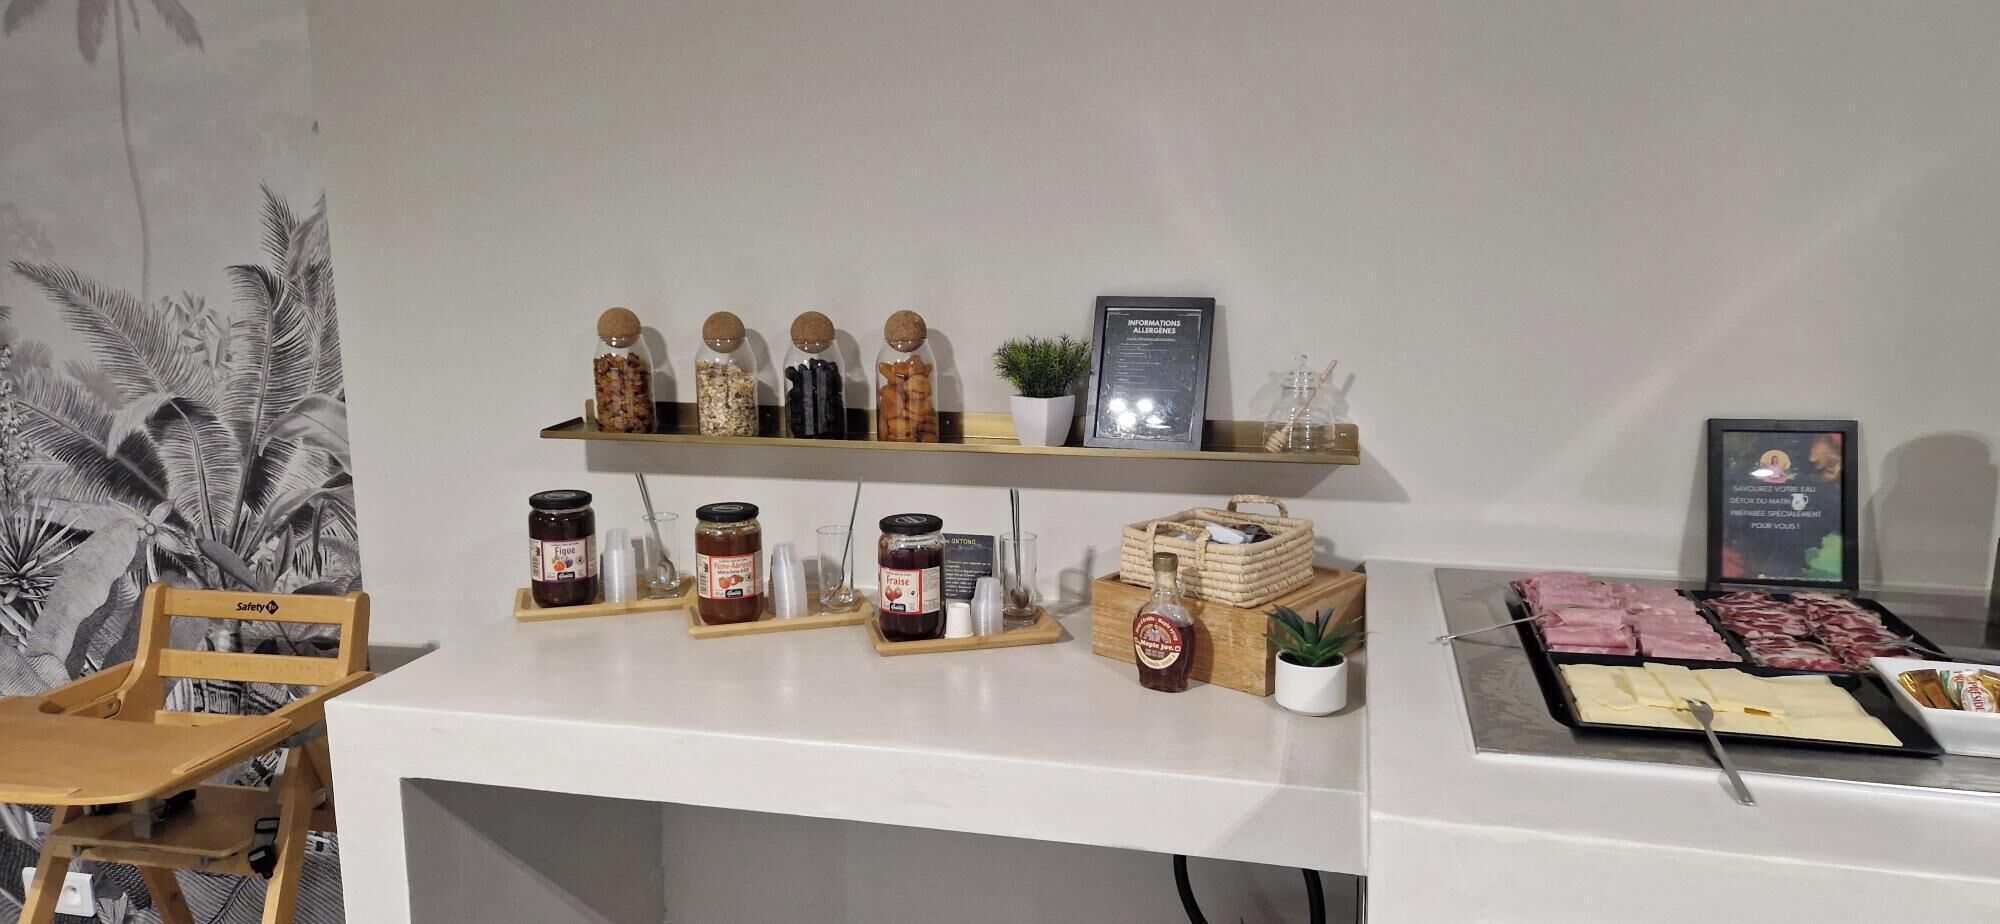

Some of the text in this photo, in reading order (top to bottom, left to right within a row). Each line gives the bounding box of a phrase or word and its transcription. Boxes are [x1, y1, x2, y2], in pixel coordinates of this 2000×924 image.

[1127, 319, 1181, 327] INFORMATIONS
[1732, 485, 1772, 493] SAVOUREZ
[1774, 485, 1799, 493] VOTRE
[555, 546, 576, 556] Figue
[886, 575, 910, 586] Fraise
[236, 602, 265, 613] Safety
[1140, 639, 1174, 651] Maple Joe
